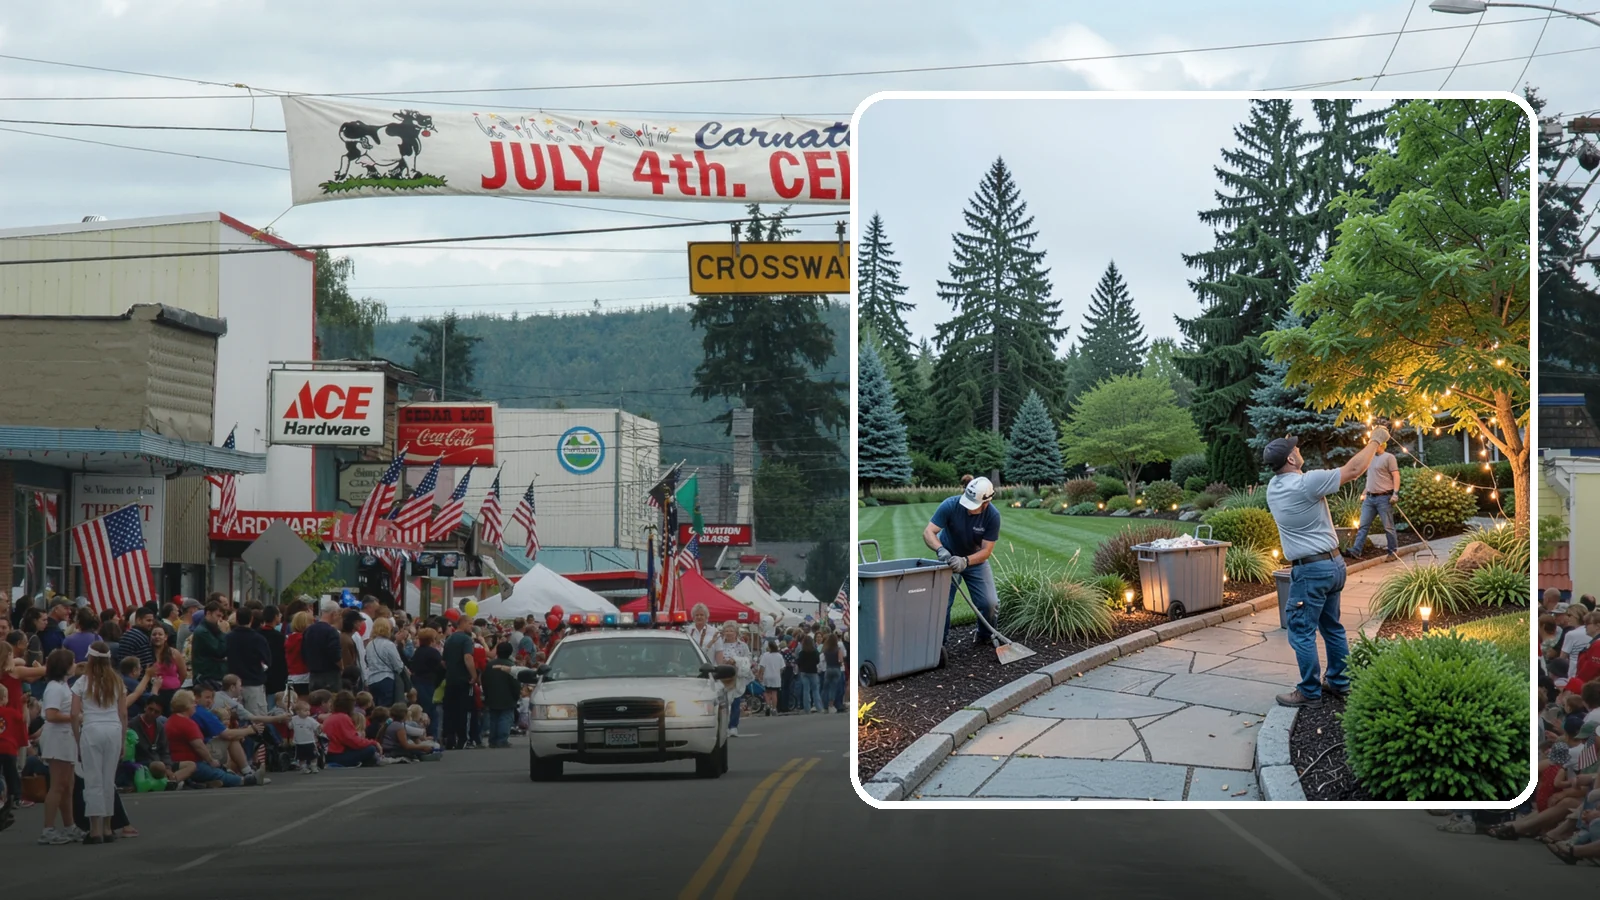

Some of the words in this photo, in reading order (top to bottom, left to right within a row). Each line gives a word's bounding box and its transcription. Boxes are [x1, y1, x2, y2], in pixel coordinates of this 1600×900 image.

[481, 141, 604, 192] JULY
[632, 149, 746, 197] 4th.
[697, 254, 850, 280] CROSSWA
[282, 379, 373, 420] ACE
[405, 409, 452, 422] CEDAR
[283, 421, 370, 437] Hardware
[416, 427, 476, 447] Coca-Cola
[353, 467, 384, 482] Simpl
[95, 485, 124, 495] Vincent
[126, 486, 136, 495] de
[138, 486, 155, 495] Paul
[688, 526, 741, 535] CRNATION
[699, 535, 730, 543] GLASS
